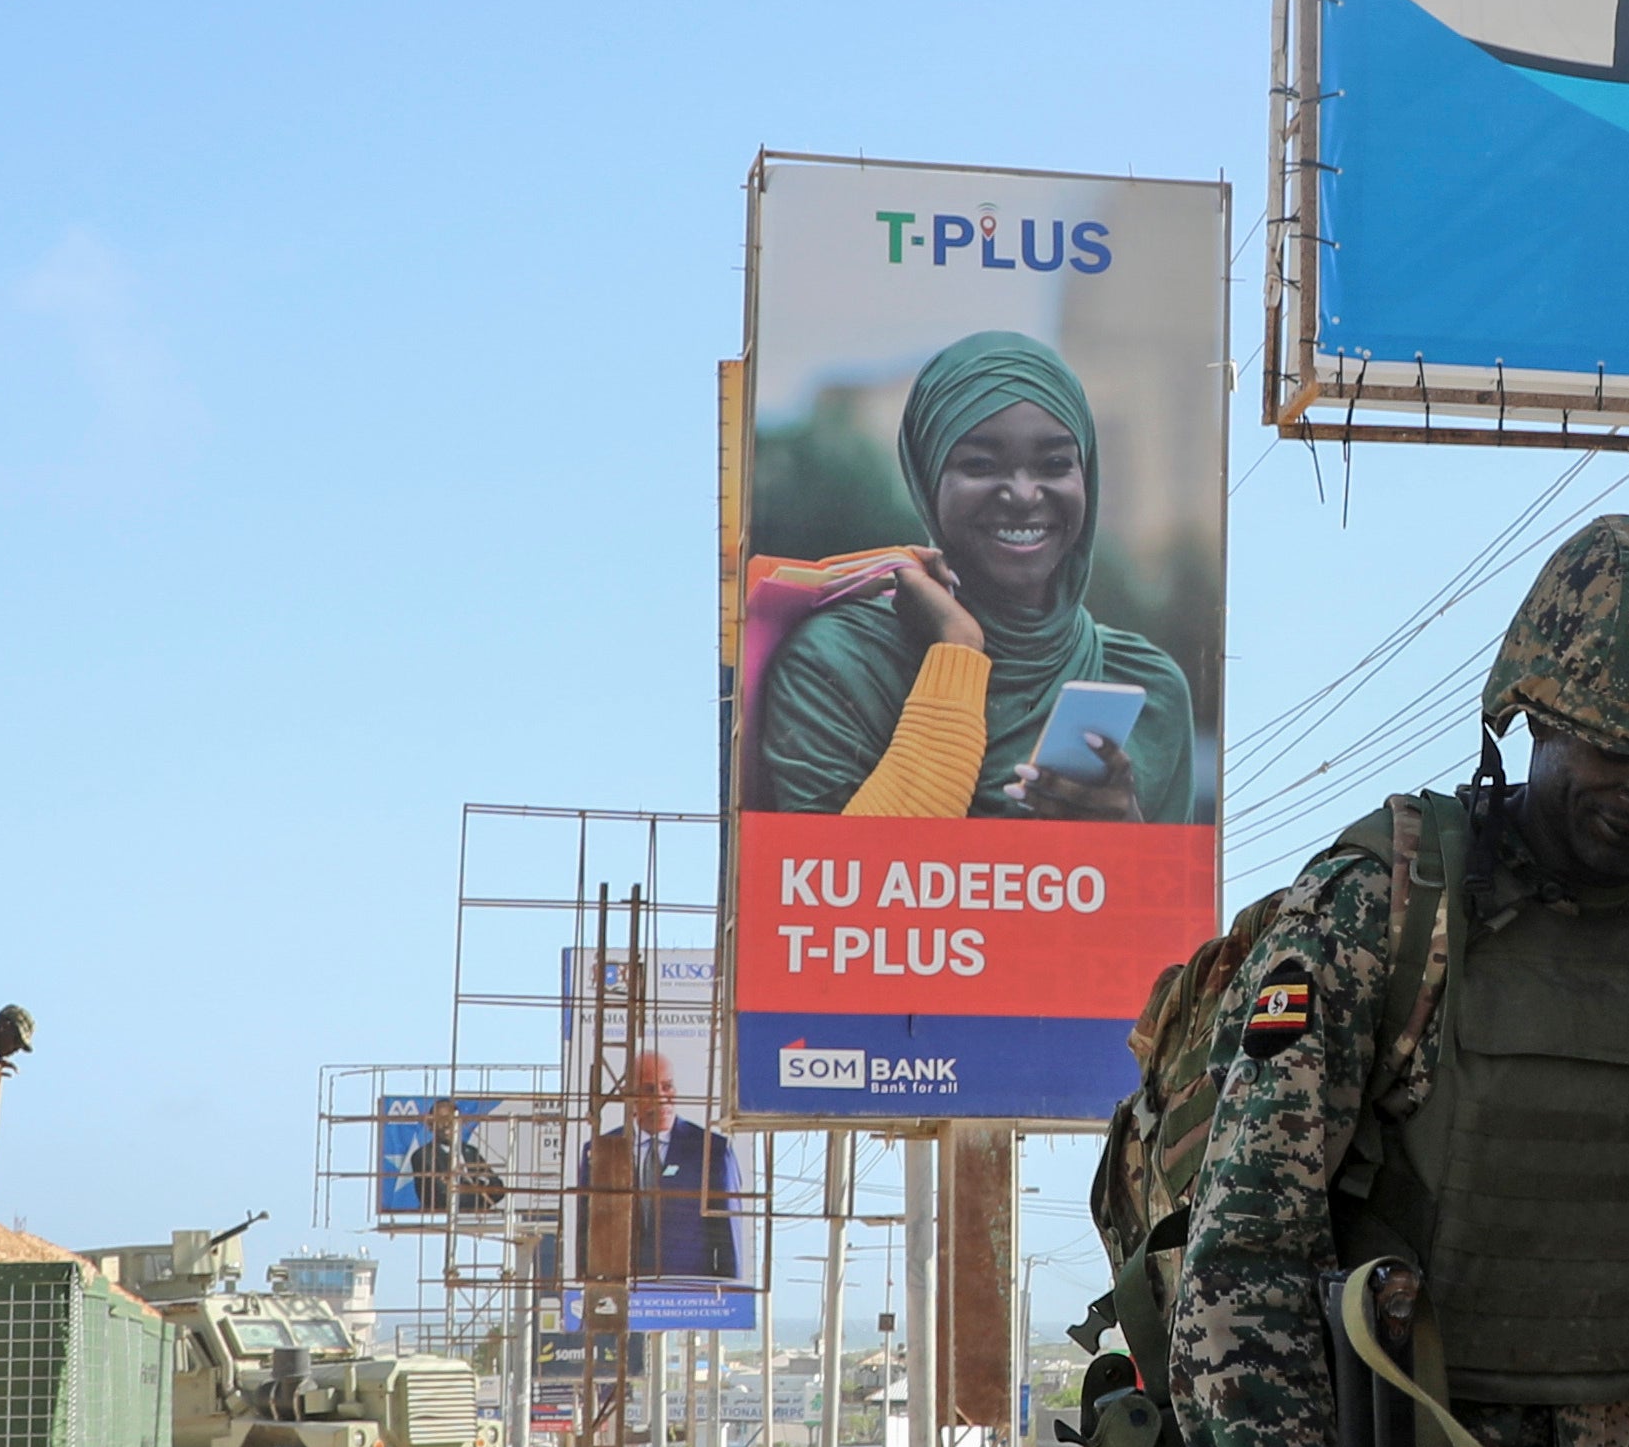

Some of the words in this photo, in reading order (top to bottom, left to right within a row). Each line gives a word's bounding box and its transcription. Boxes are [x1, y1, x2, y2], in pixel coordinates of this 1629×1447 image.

[876, 210, 1113, 275] T-PLUS
[780, 858, 862, 908] KU
[876, 861, 1107, 914] ADEEGO
[778, 925, 987, 977] T-PLUS
[870, 1082, 907, 1094] Bank
[912, 1082, 933, 1094] for
[939, 1082, 958, 1094] all
[555, 1345, 598, 1361] somtl
